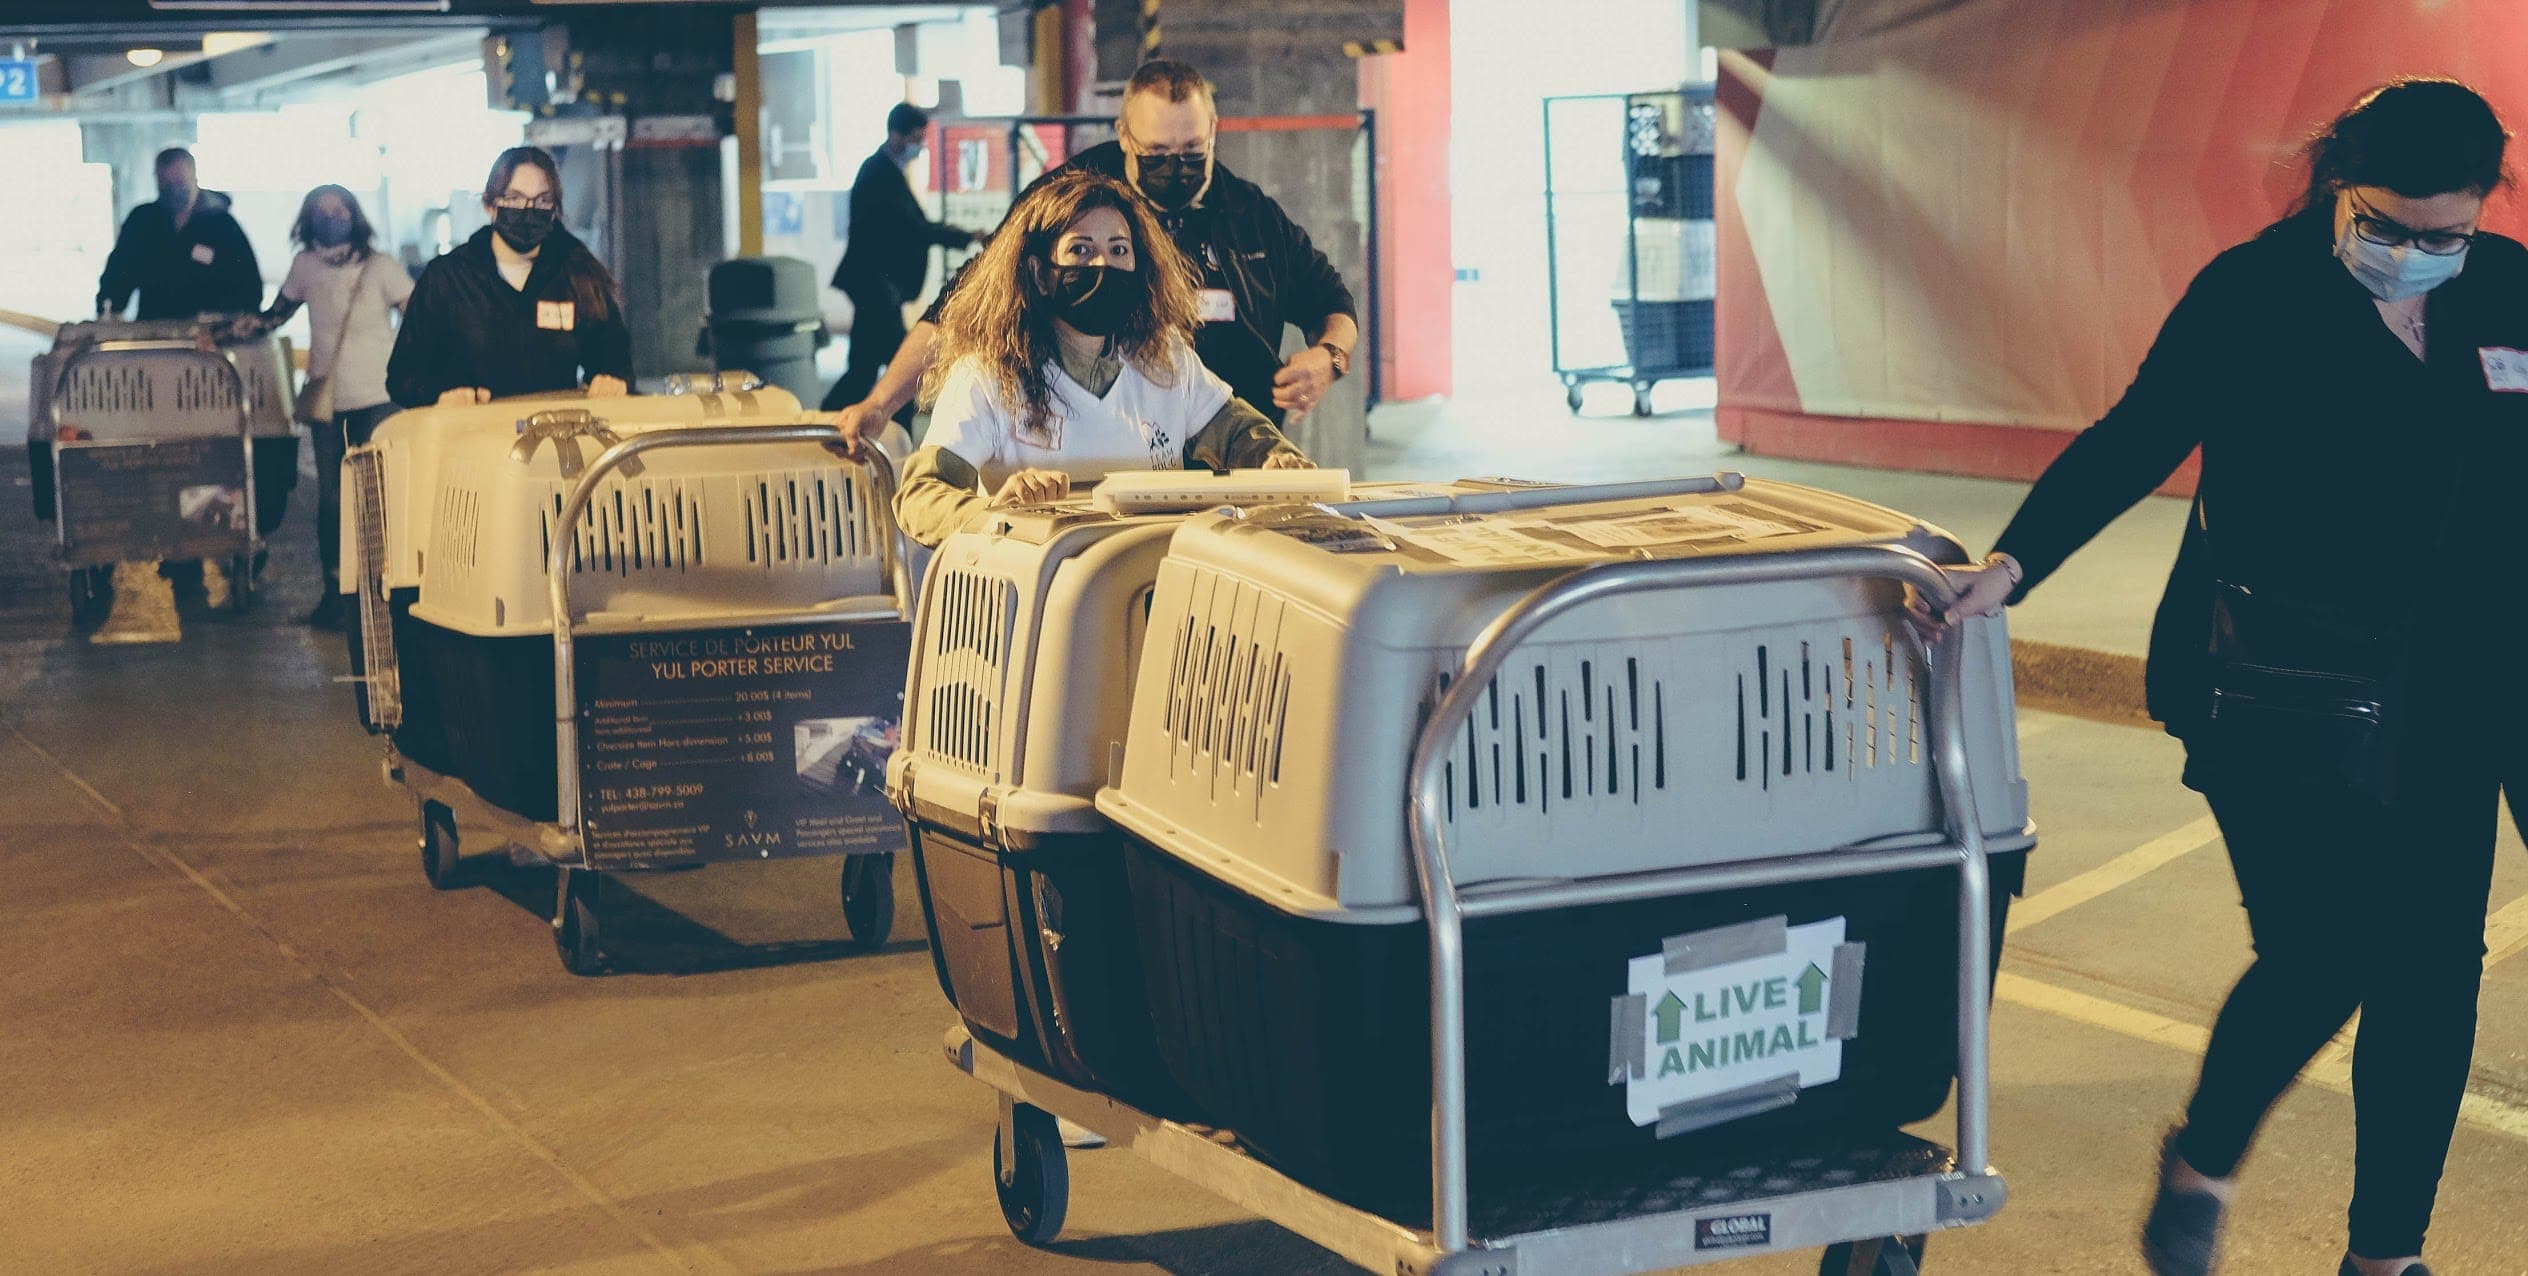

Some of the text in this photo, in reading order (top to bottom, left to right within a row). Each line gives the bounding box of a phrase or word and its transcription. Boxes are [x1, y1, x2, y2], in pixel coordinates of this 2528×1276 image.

[629, 633, 855, 659] SERVICE DE PORTEUR YUL
[651, 653, 833, 680] YUL PORTER SERVICE
[594, 699, 638, 708] Minimum
[631, 759, 658, 770] Cage
[1694, 976, 1788, 1023] LIVE
[1657, 1019, 1819, 1079] ANIMAL
